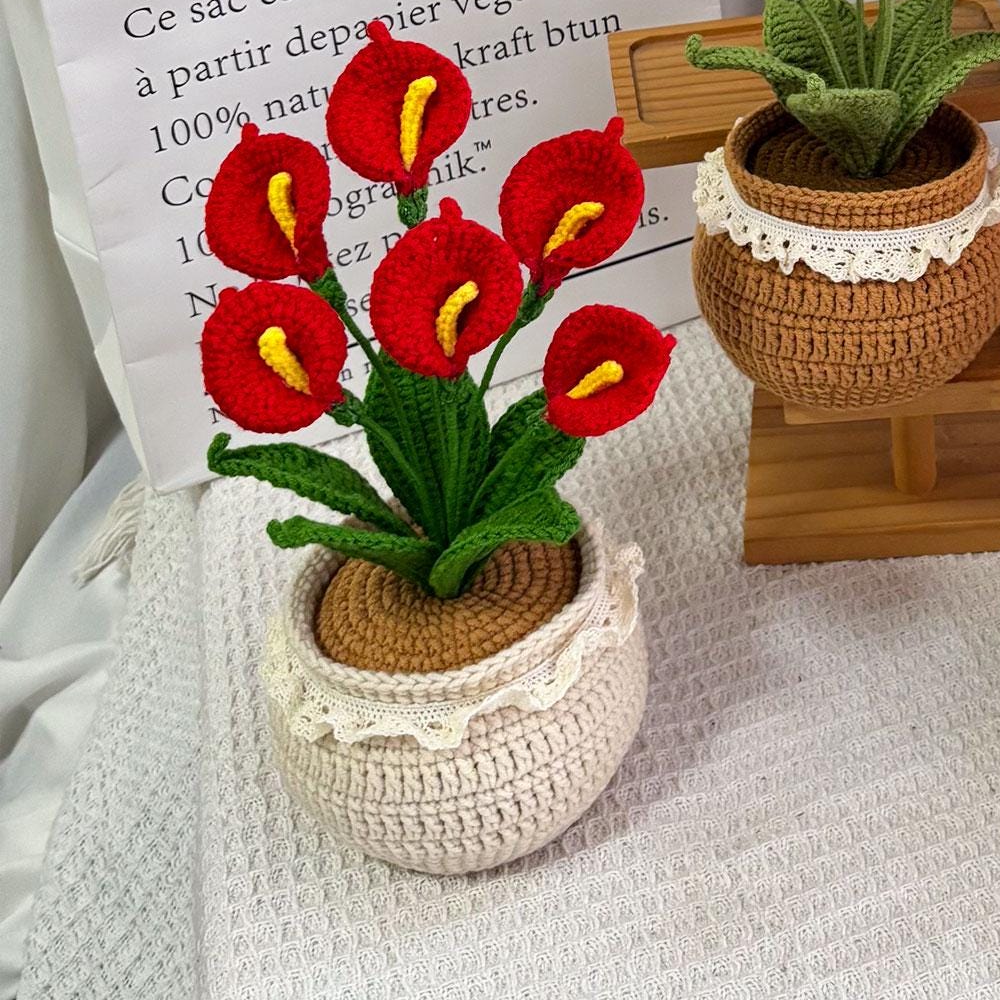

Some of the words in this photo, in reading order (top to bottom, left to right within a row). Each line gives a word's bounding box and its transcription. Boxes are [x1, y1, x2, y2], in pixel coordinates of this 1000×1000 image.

[123, 6, 178, 38] Ce
[135, 67, 158, 98] à
[166, 39, 272, 100] partir
[149, 101, 250, 154] 100%
[453, 26, 537, 70] kraft
[542, 12, 623, 48] btun
